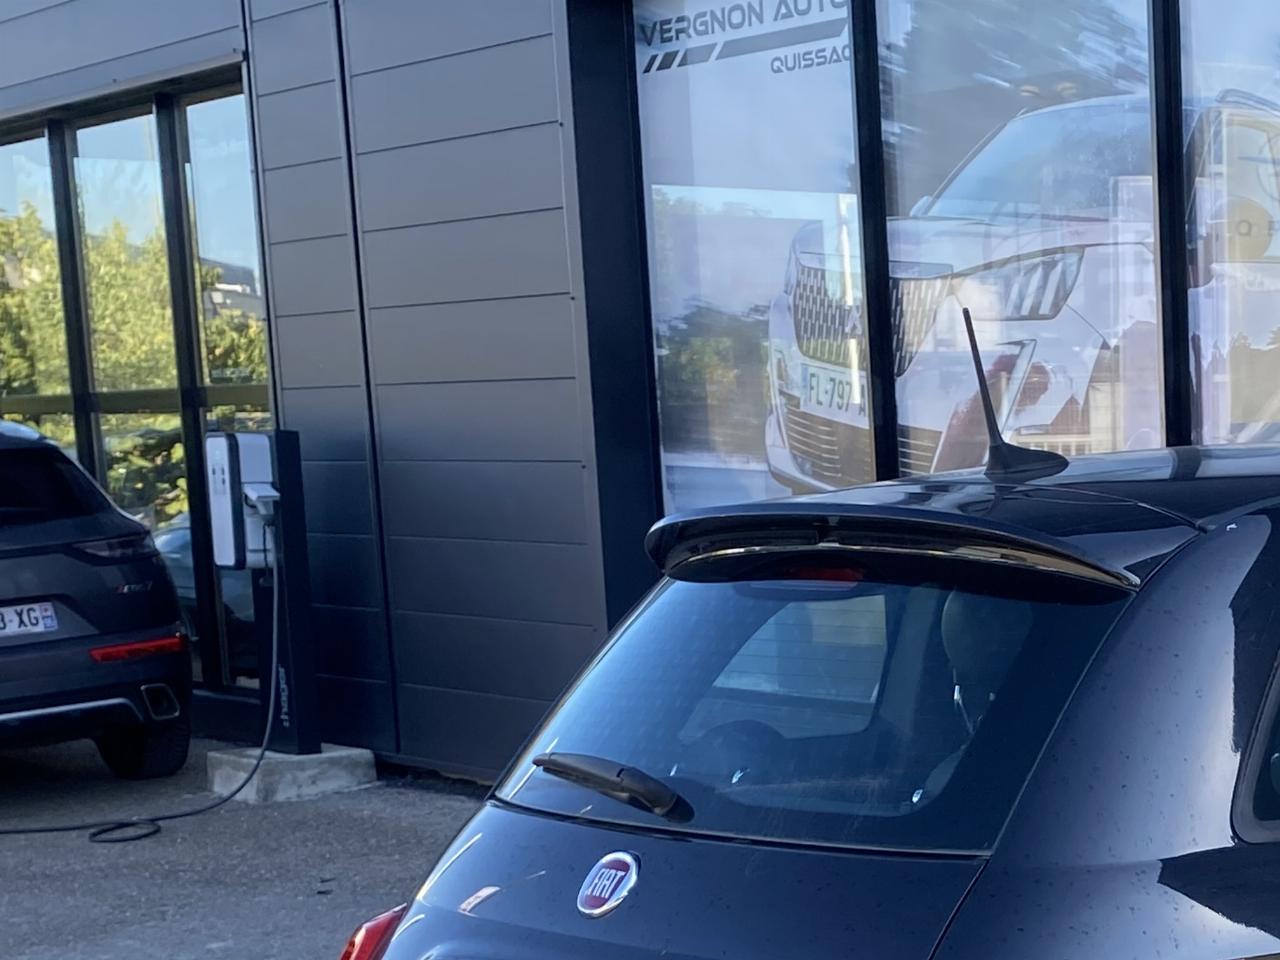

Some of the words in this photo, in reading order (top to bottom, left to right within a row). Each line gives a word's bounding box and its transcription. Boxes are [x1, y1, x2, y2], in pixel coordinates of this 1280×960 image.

[640, 0, 764, 47] VERGNON
[770, 44, 850, 74] QUISSAC
[587, 867, 627, 899] FIAT
